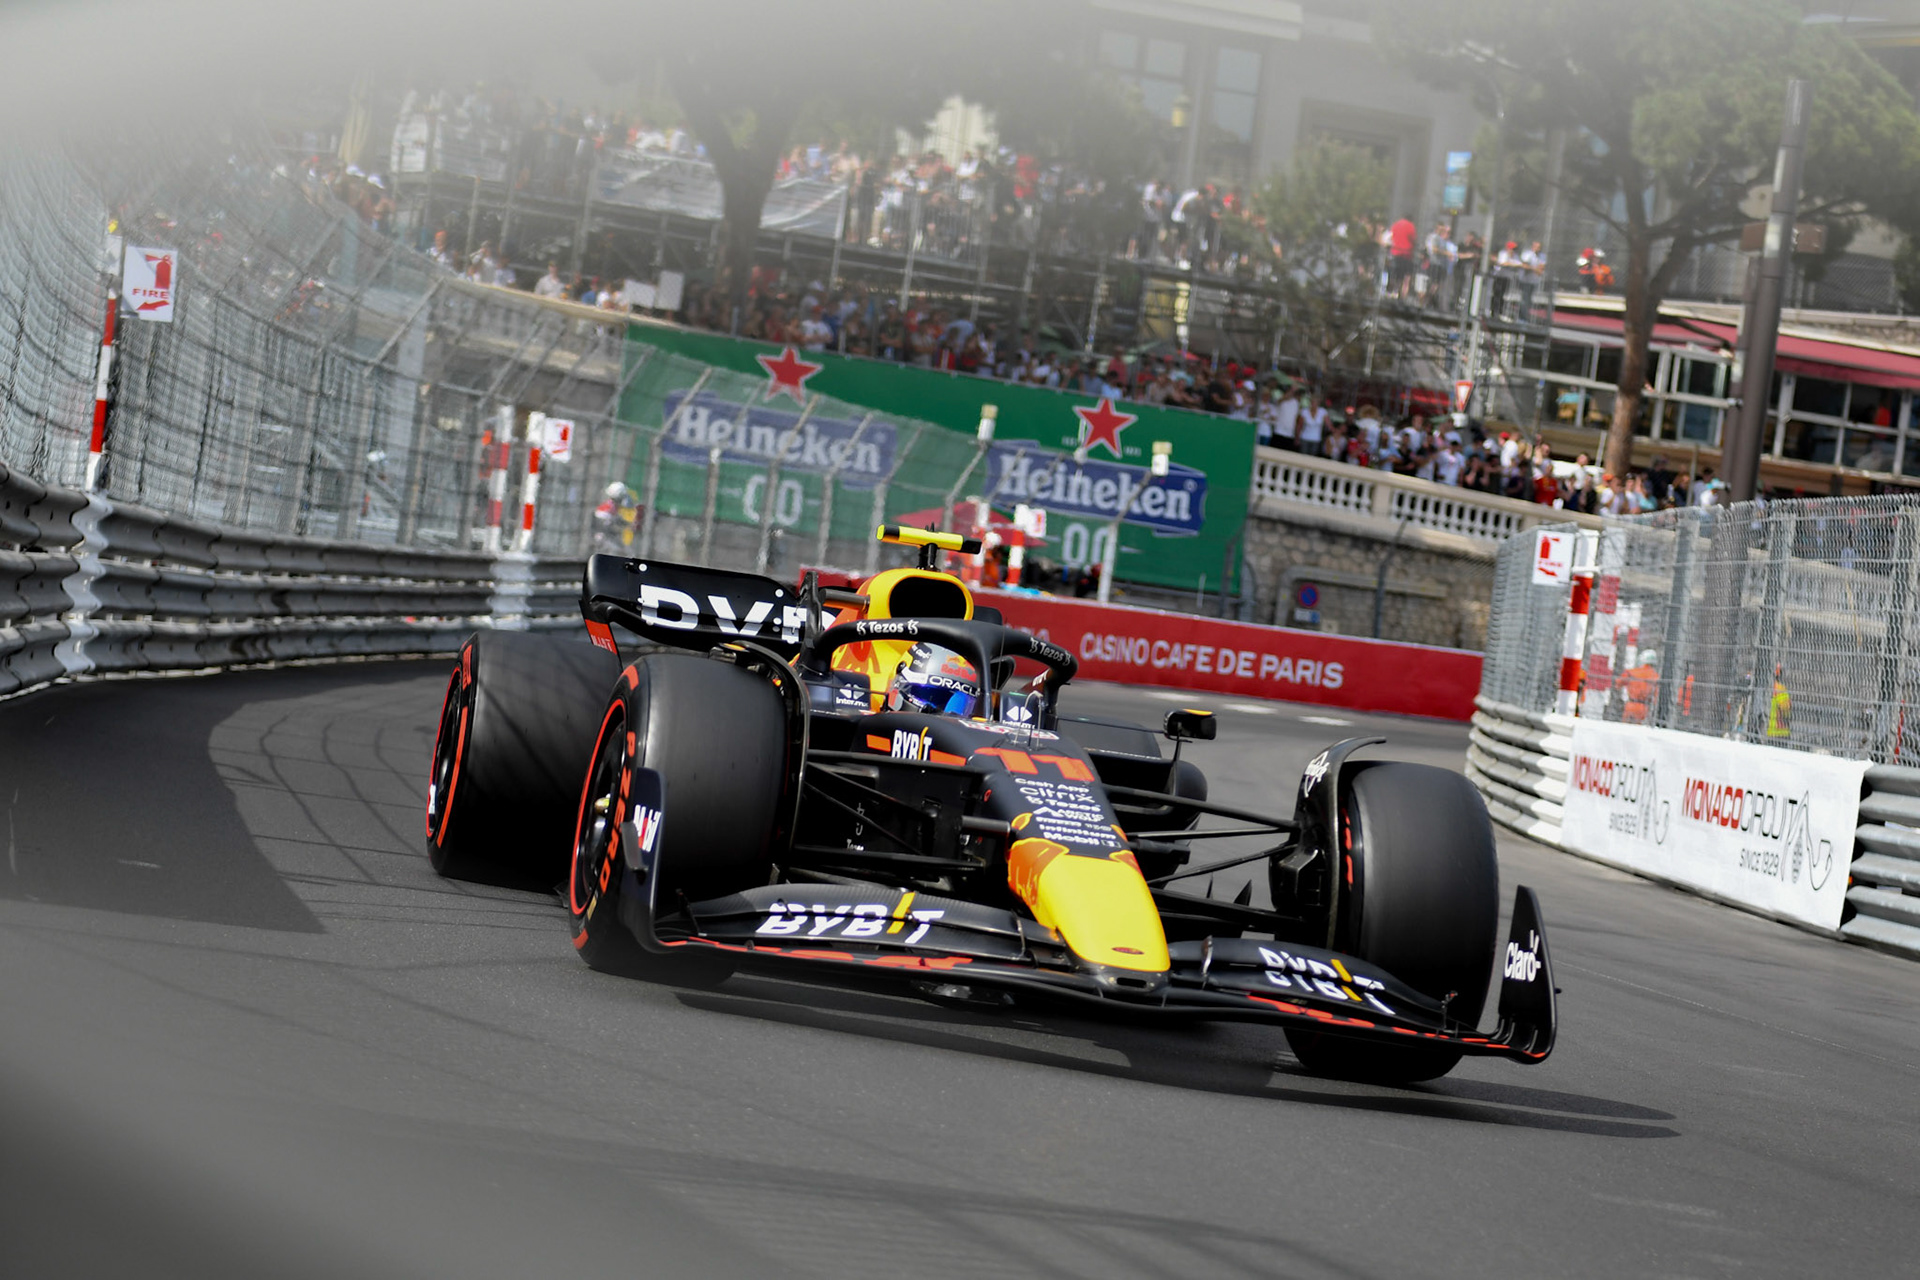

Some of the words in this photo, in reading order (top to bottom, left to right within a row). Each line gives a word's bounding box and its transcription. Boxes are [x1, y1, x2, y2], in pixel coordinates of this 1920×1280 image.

[132, 288, 169, 300] FIRE
[677, 404, 881, 474] Heineken
[998, 453, 1192, 521] Heineken
[868, 621, 904, 633] Tezos
[1039, 642, 1064, 662] Tezos
[1080, 632, 1149, 666] CASINO
[1152, 640, 1213, 673] CAFE
[1217, 647, 1256, 678] DE
[1260, 656, 1345, 690] PARIS
[975, 747, 1095, 782] 11
